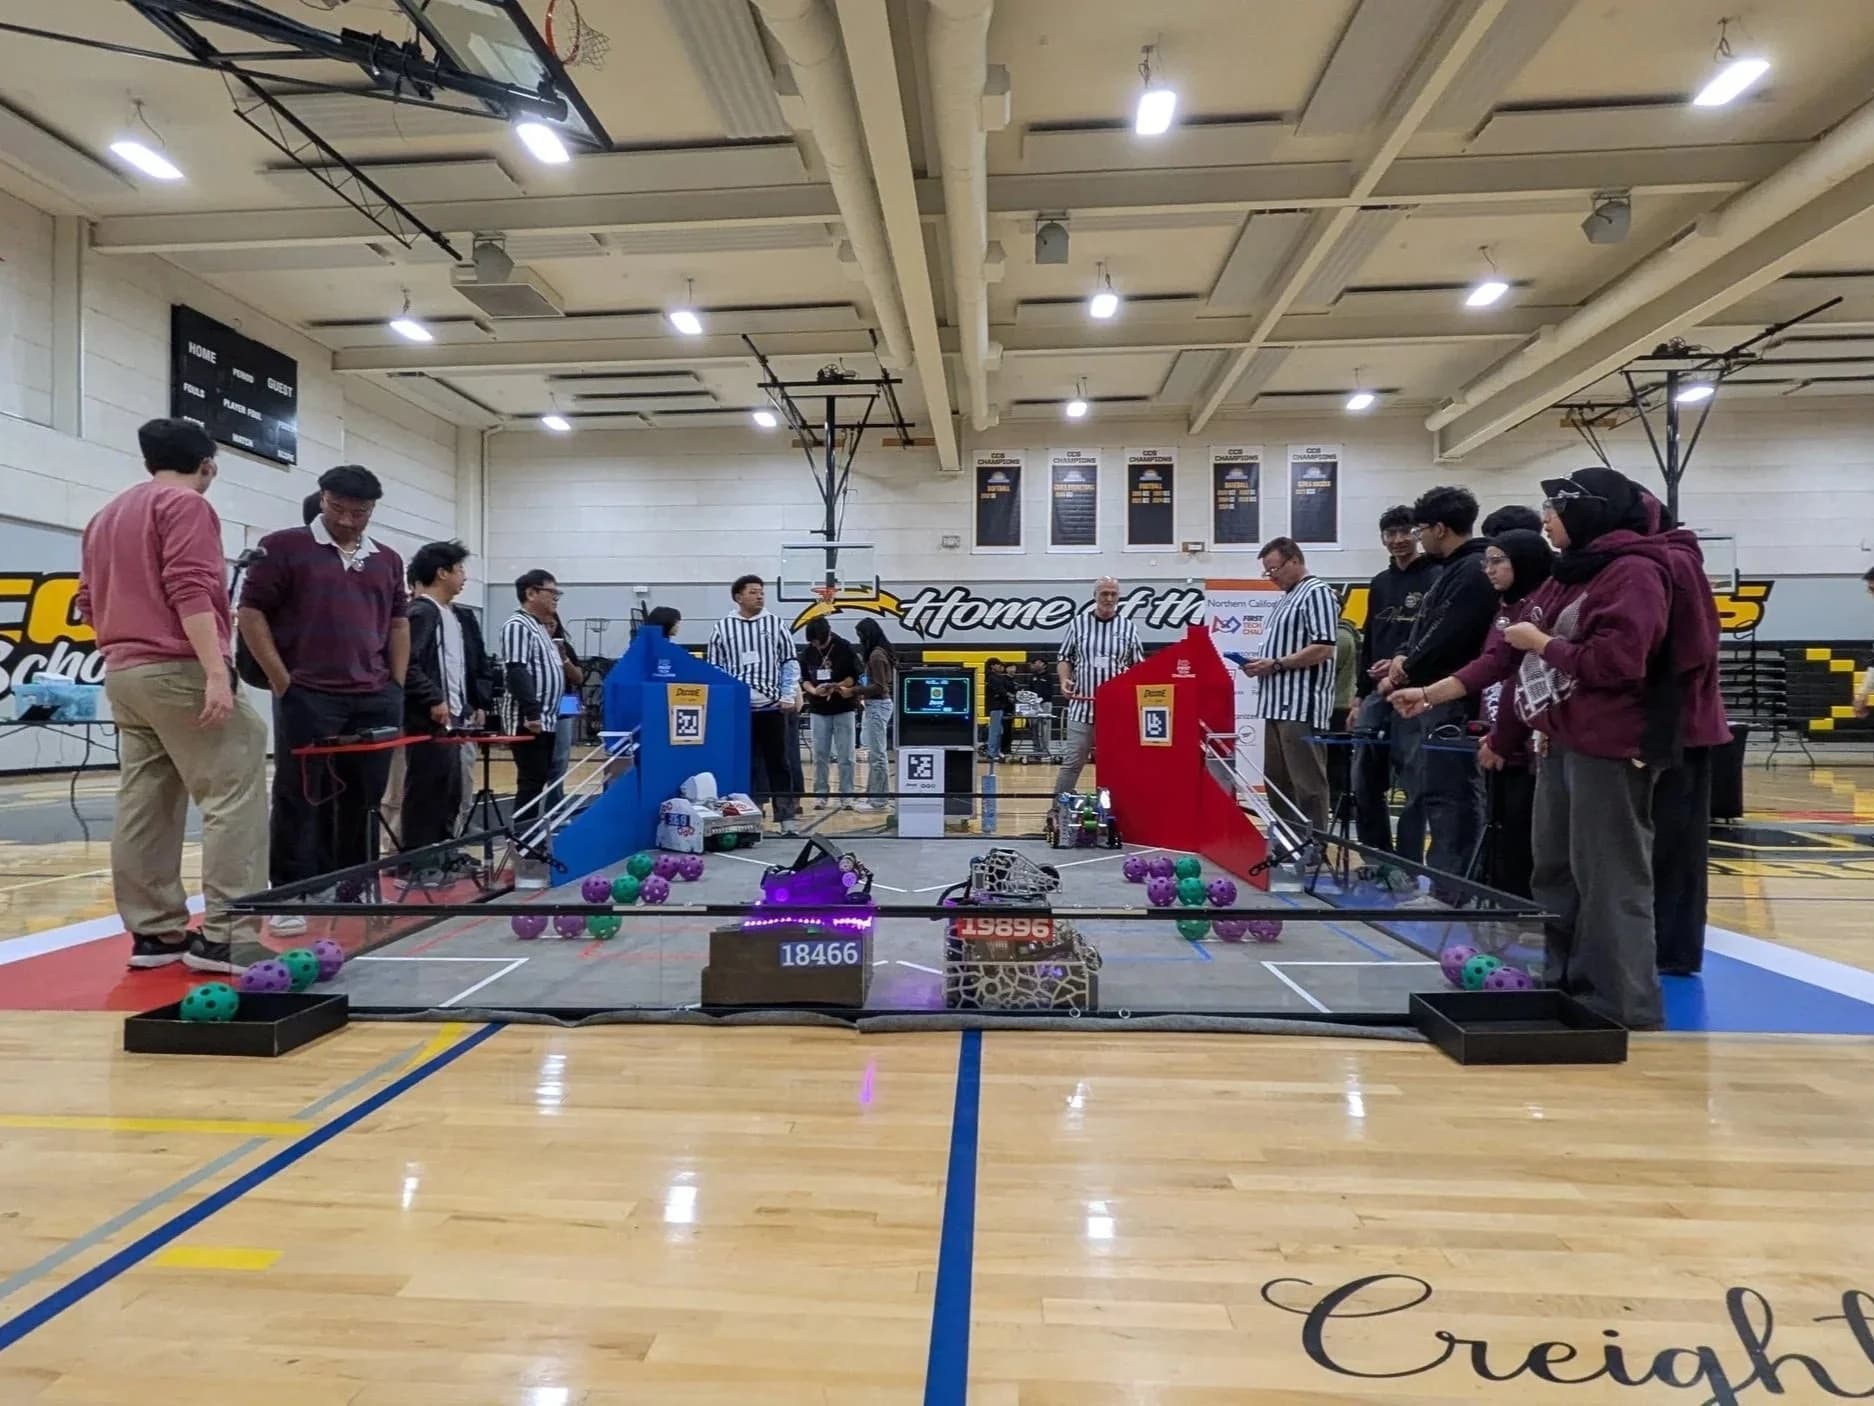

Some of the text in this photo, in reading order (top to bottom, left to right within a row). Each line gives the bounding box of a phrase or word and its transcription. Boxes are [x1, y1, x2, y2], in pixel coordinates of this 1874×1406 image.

[188, 340, 217, 364] HOME
[232, 367, 254, 384] PERIOD
[183, 382, 205, 399] FOULS
[267, 377, 293, 398] GUEST
[223, 398, 246, 415] PLAYER
[897, 586, 1076, 638] Home
[1207, 599, 1247, 608] Northern
[962, 917, 1050, 938] 19896
[782, 942, 858, 966] 18466
